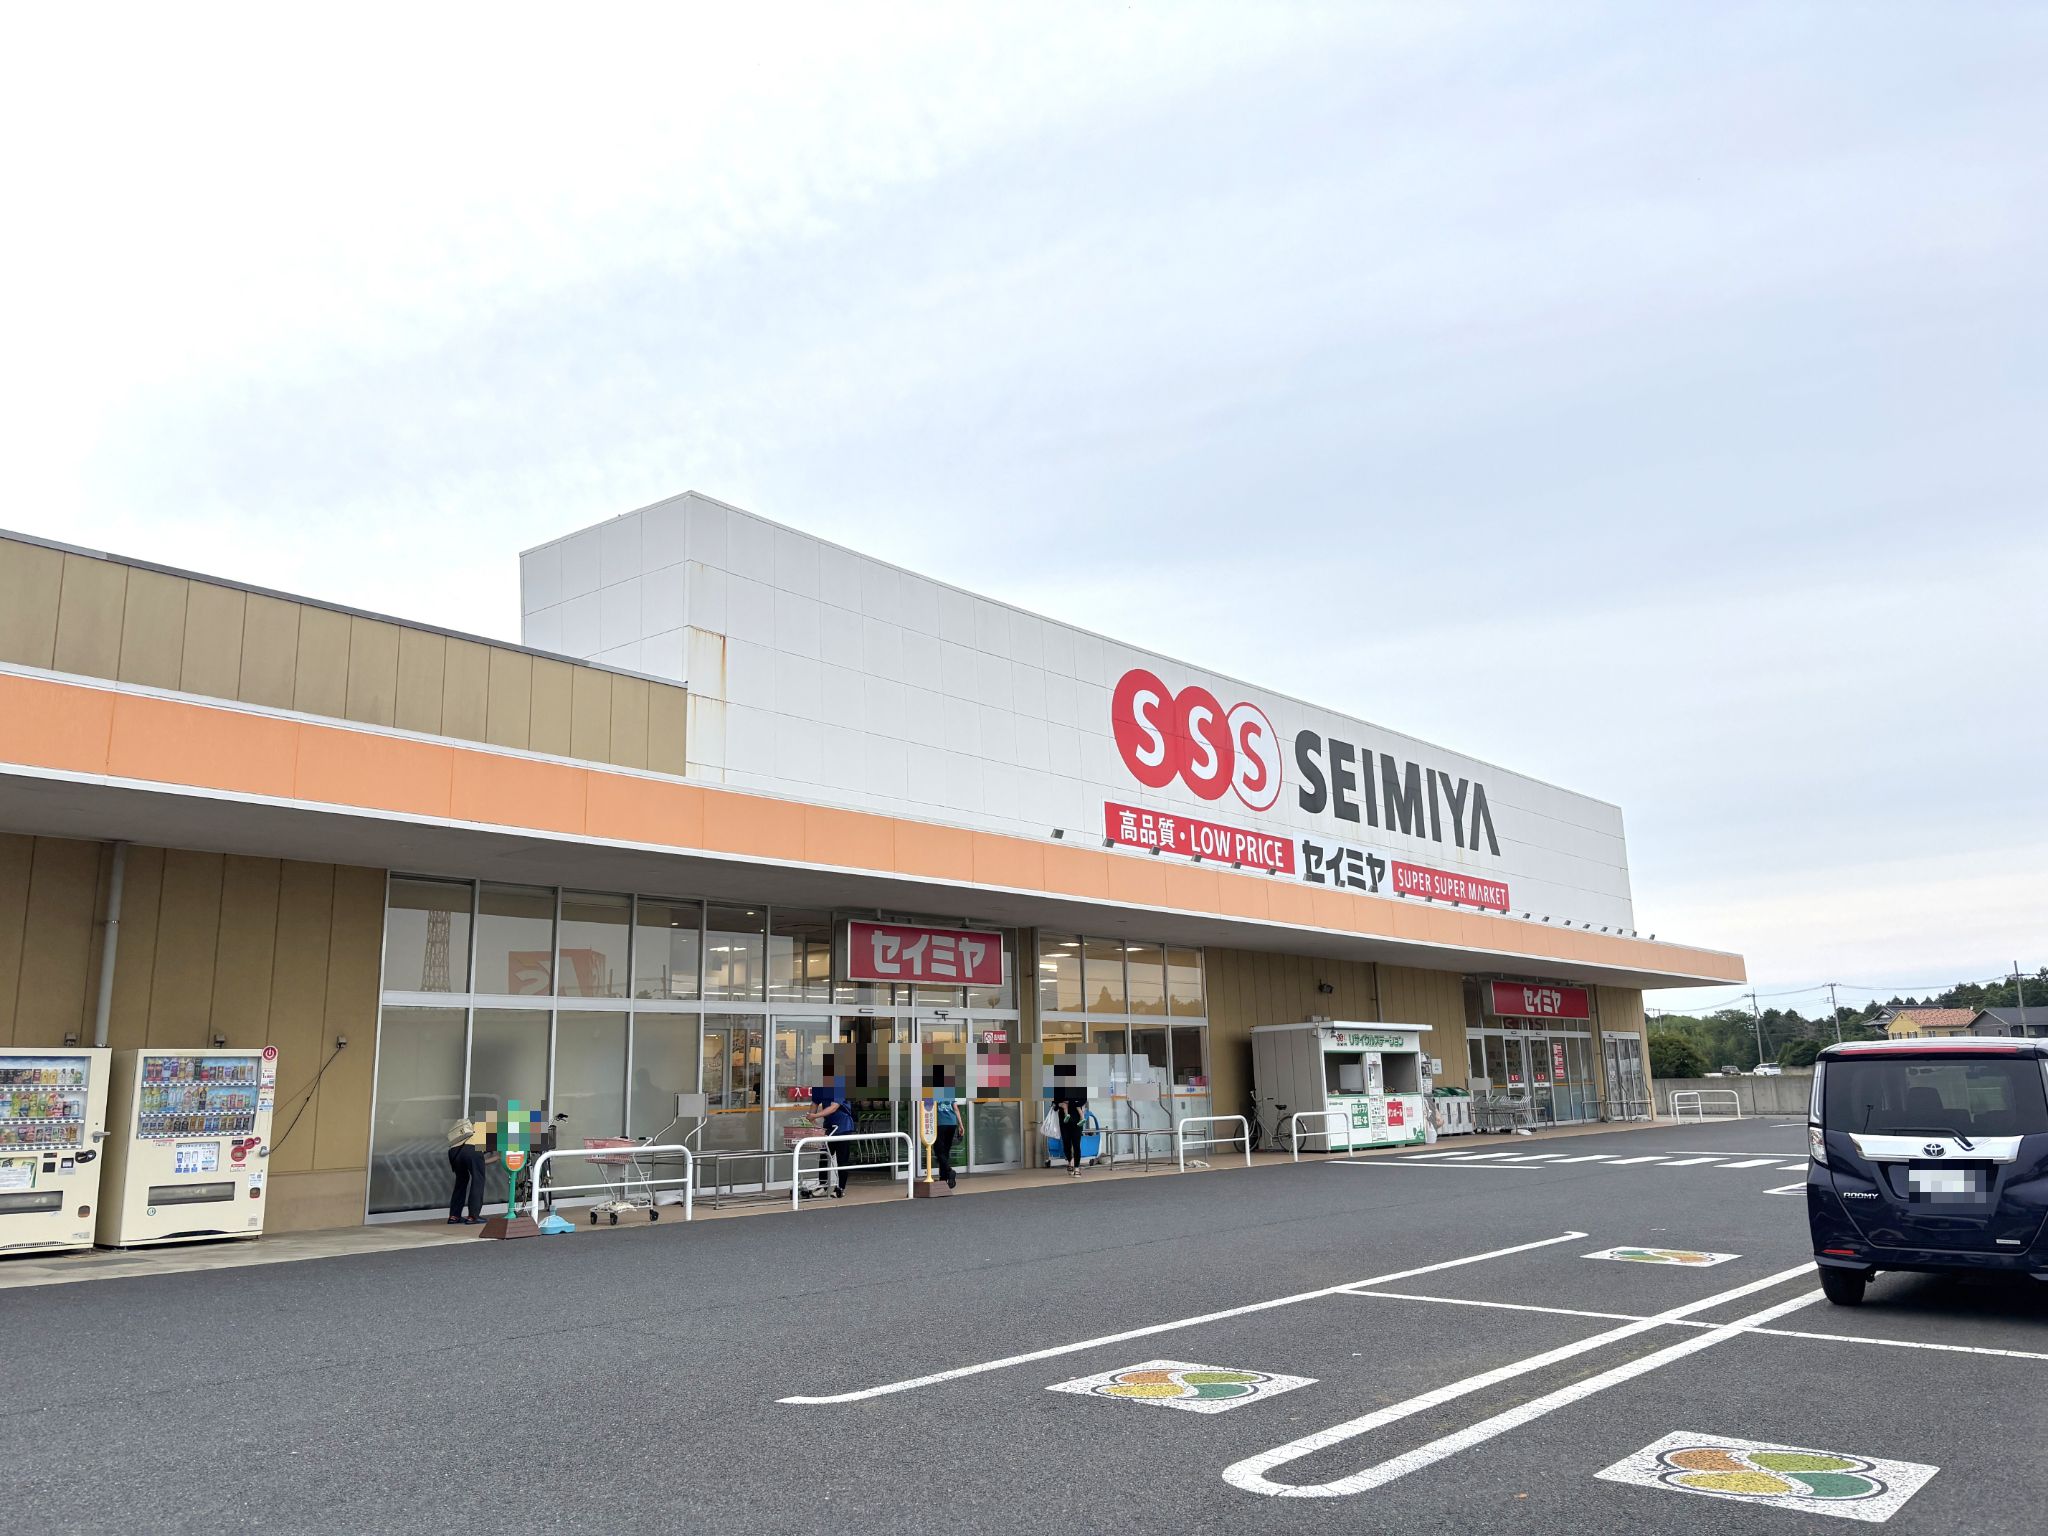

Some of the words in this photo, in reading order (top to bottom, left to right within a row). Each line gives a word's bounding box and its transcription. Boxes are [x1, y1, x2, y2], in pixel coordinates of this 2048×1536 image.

[1294, 729, 1501, 857] SEIMIYA
[1235, 833, 1284, 868] PRICE
[1301, 839, 1386, 893] セイミヤ
[1397, 868, 1433, 893] SUPER
[1434, 876, 1466, 899] SUPER
[1468, 884, 1506, 906] MARKET
[870, 929, 986, 978] セイミヤ
[1522, 986, 1562, 1014] セイミヤ
